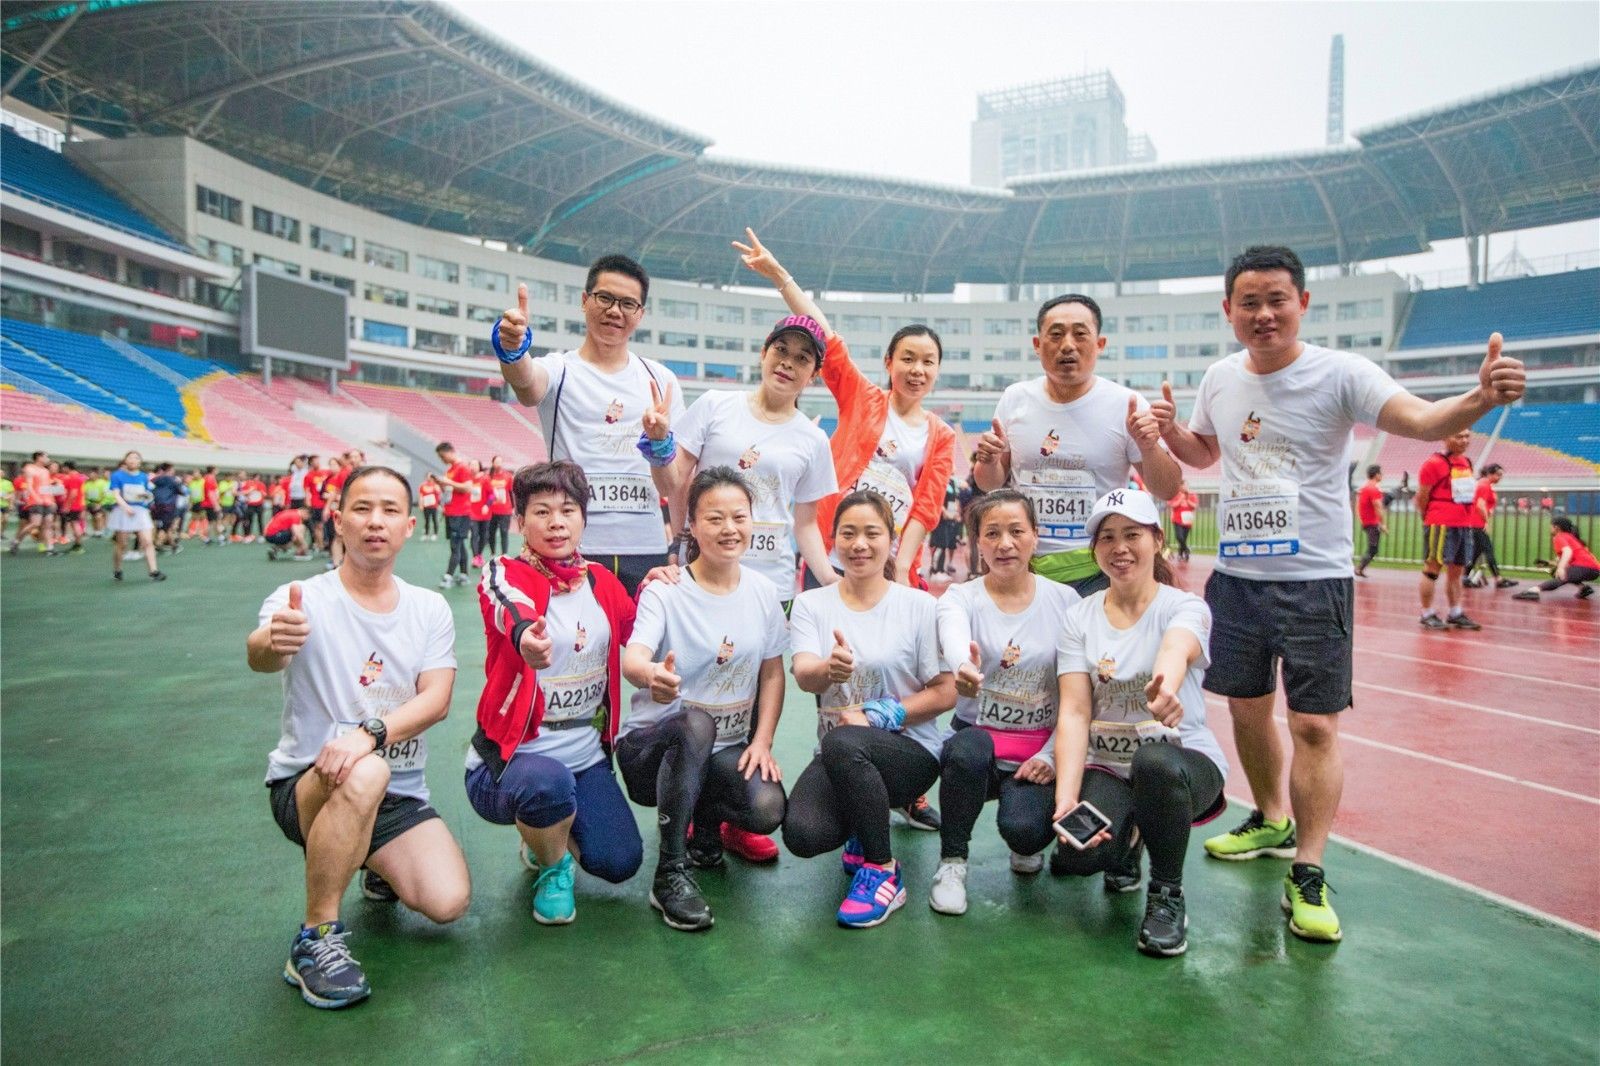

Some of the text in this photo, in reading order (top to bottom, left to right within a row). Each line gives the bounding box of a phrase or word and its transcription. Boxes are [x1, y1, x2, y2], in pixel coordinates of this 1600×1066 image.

[588, 484, 648, 502] A13644
[1226, 509, 1288, 532] A13648
[986, 703, 1053, 725] A22135
